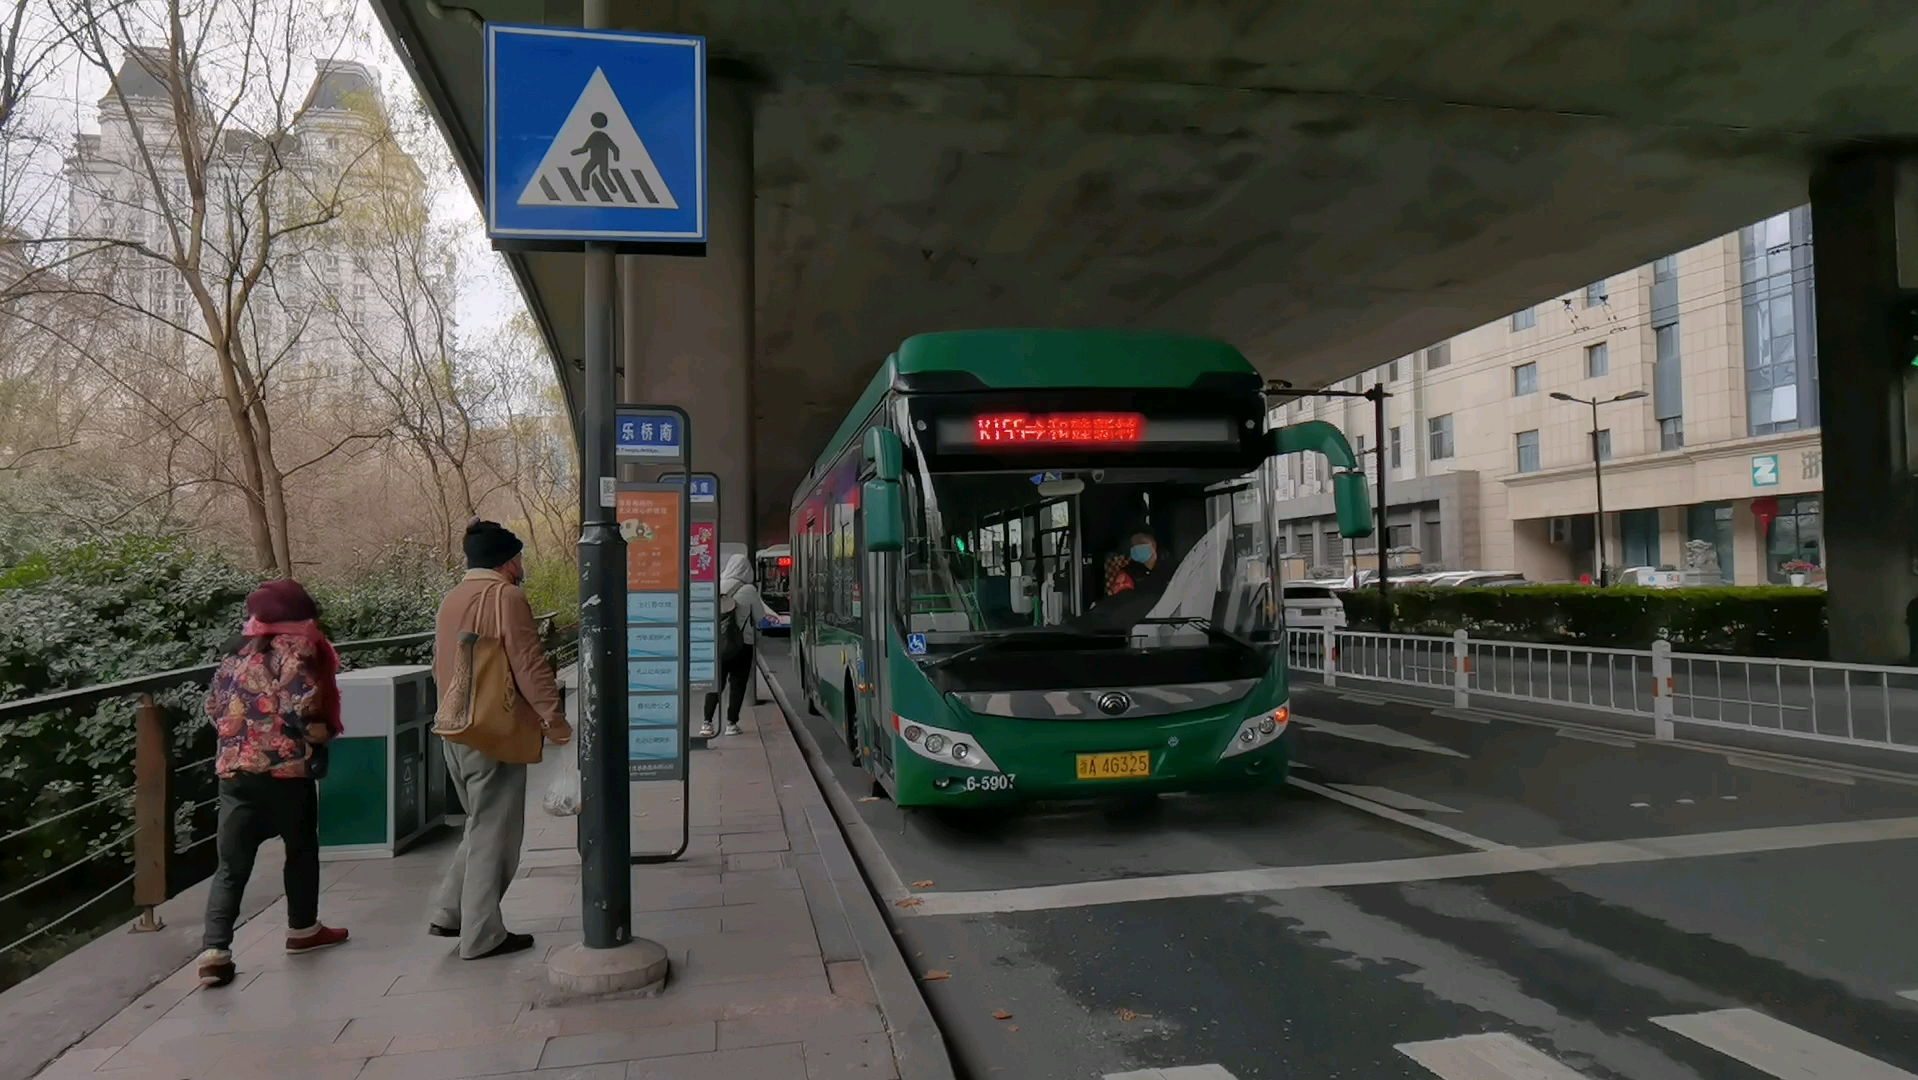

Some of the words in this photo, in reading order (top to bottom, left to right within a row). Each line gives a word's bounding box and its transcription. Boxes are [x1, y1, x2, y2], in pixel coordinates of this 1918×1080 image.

[621, 421, 674, 442] 乐桥南
[966, 773, 1016, 791] 6-5907
